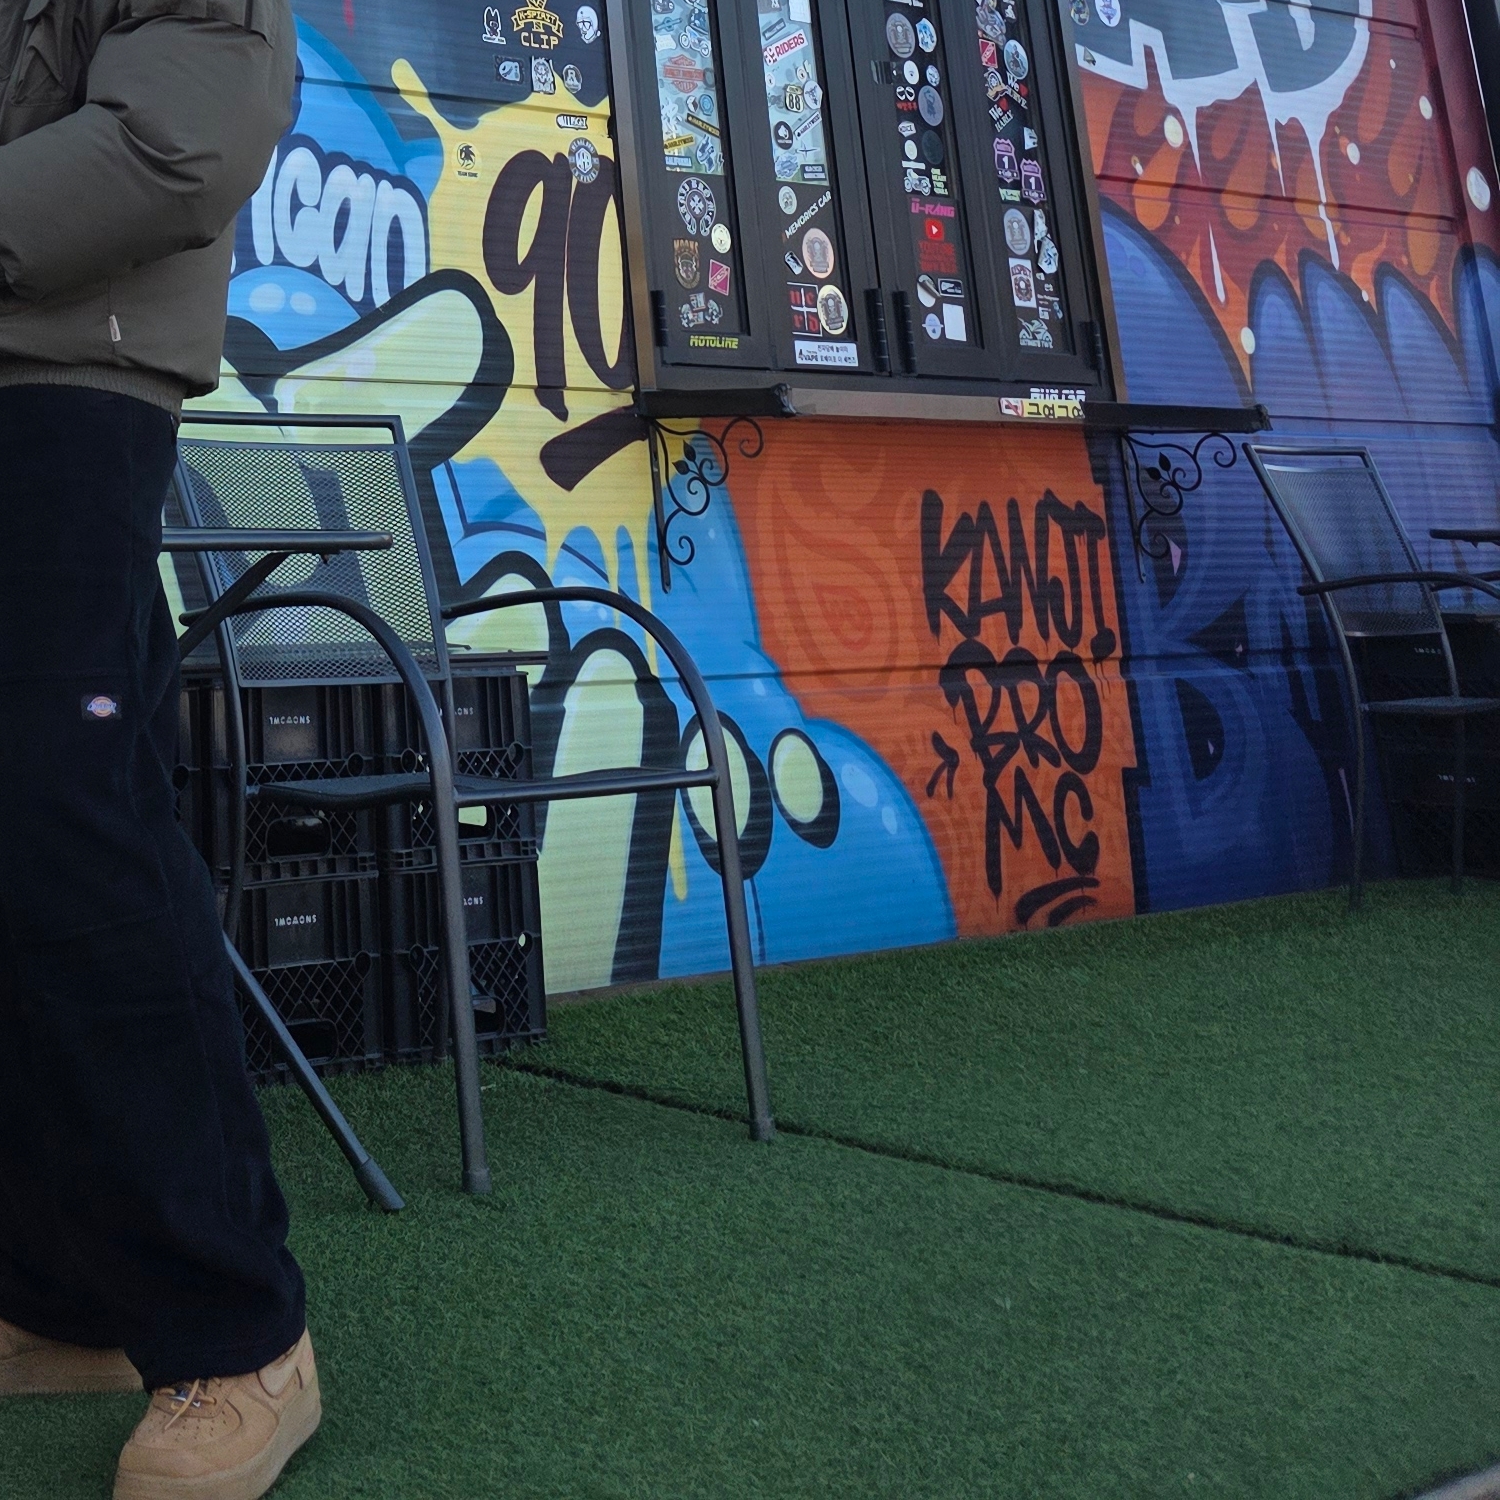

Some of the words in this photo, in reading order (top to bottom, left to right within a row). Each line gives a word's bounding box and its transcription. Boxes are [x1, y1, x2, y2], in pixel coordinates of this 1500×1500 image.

[518, 7, 557, 26] K-SPIRIT
[521, 33, 559, 50] CLIP
[775, 33, 806, 59] RIDERS
[816, 191, 832, 207] CAR
[482, 149, 635, 422] 90
[689, 334, 739, 351] MOTOLINE
[985, 770, 1100, 895] MC
